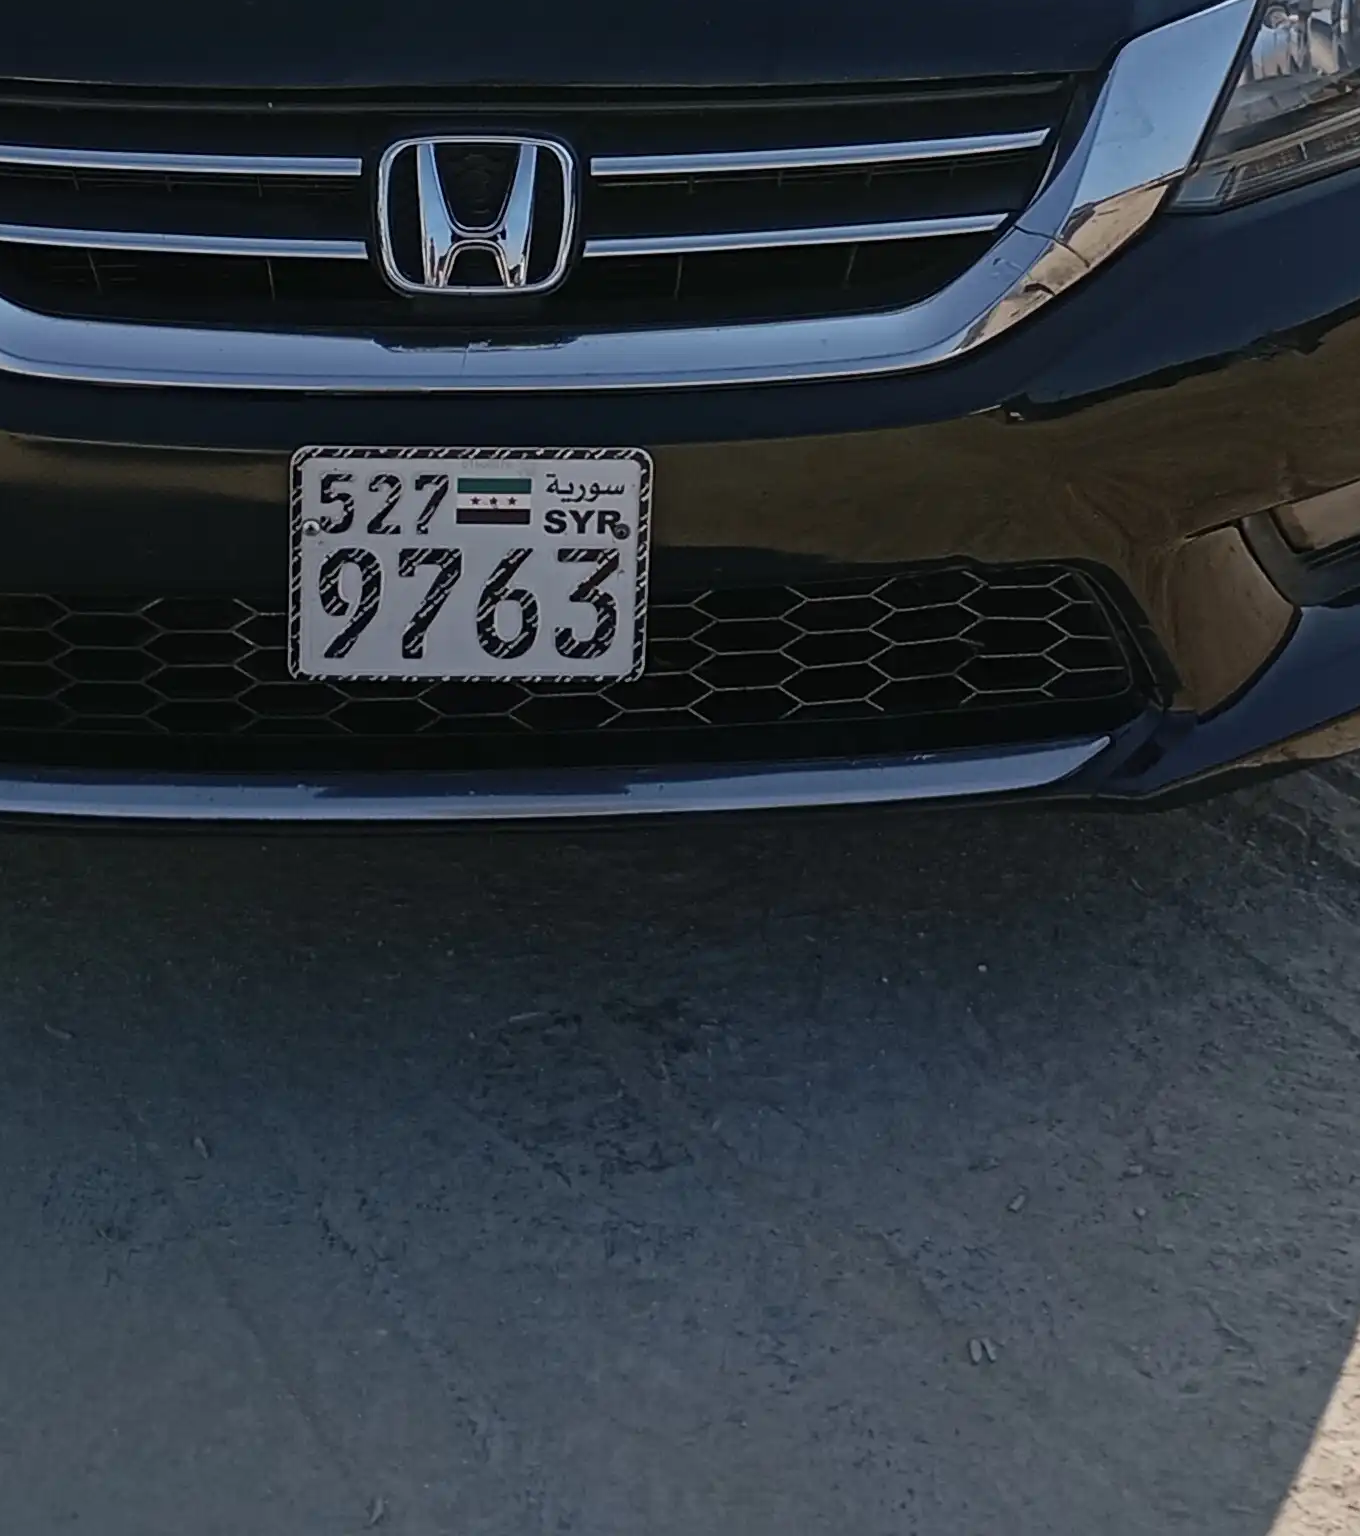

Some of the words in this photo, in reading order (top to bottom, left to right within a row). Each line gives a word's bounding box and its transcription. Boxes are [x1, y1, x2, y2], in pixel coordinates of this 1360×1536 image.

[320, 473, 449, 535] 527
[545, 473, 626, 503] سورية
[544, 509, 624, 535] SYR
[318, 547, 621, 660] 9763
